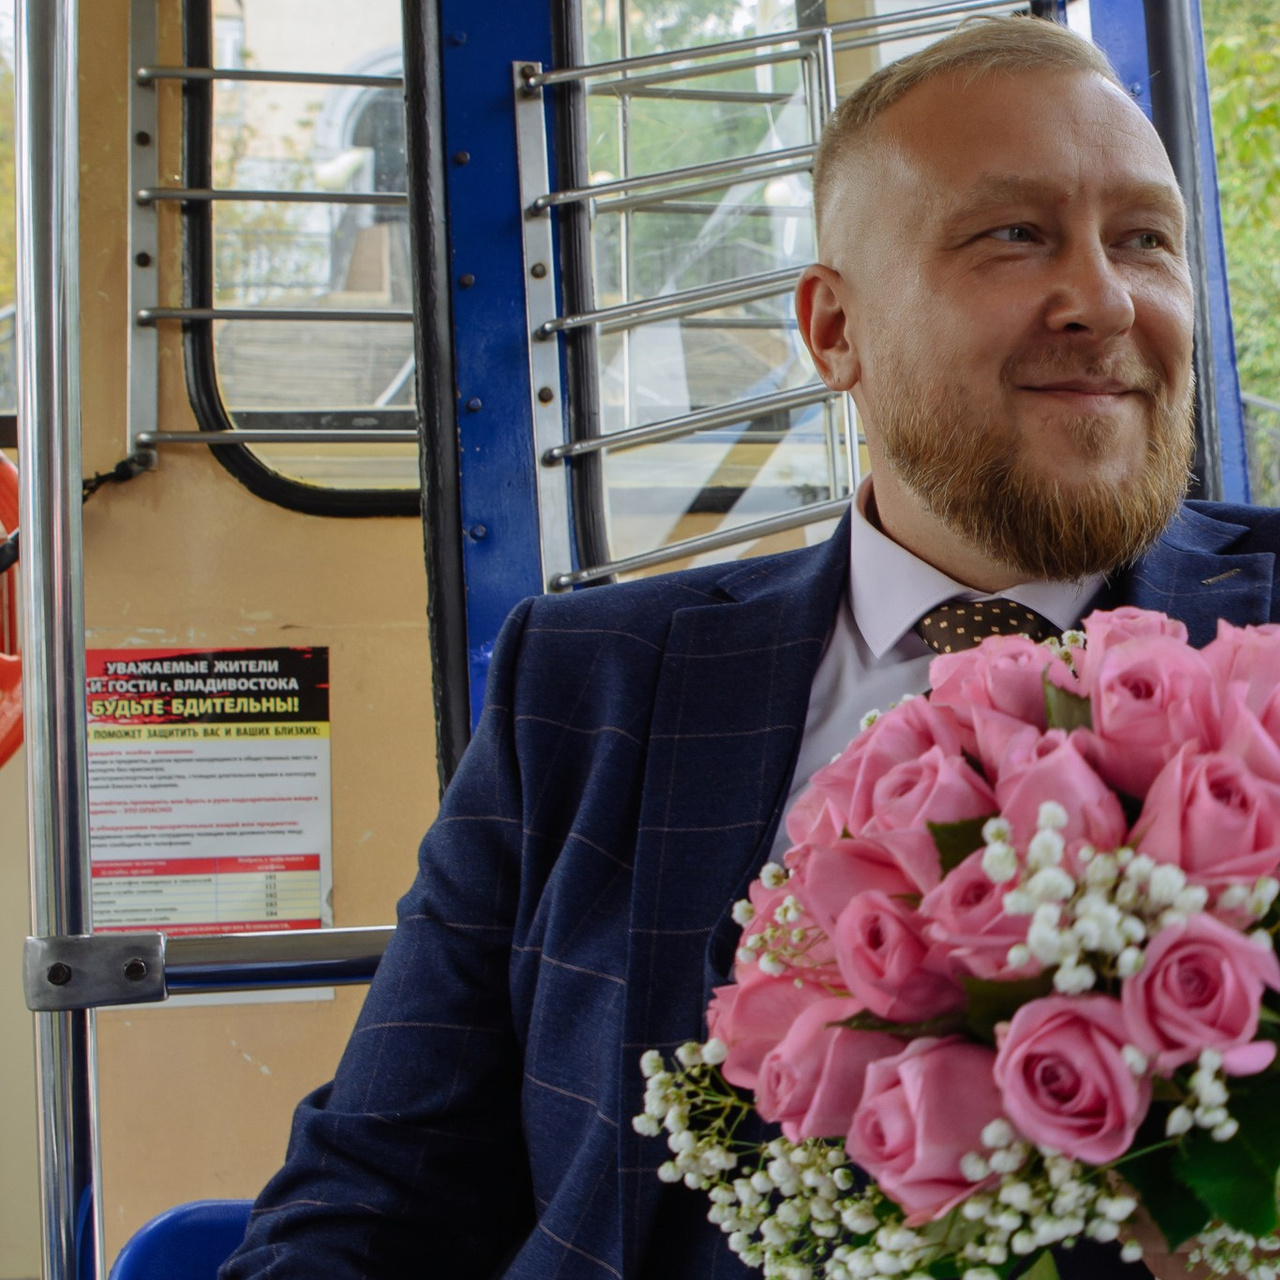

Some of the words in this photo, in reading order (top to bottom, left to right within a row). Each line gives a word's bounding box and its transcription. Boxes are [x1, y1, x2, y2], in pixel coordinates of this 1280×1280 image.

[107, 660, 208, 675] УВАЖАЕМЫЕ
[214, 660, 279, 674] ЖИТЕЛИ
[90, 680, 102, 693] И
[108, 679, 157, 693] ГОСТИ
[160, 682, 171, 692] г.
[174, 677, 299, 694] ВЛАДИВОСТОКА
[91, 698, 164, 718] БУДЬТЕ
[171, 696, 300, 716] БДИТЕЛЬНЫ!
[93, 729, 142, 740] ПОМОЖЕТ
[147, 728, 199, 739] ЗАЩИТИТЬ
[203, 727, 221, 738] ВАС
[225, 727, 232, 737] И
[236, 726, 271, 738] ВАШИХ
[274, 725, 321, 736] БЛИЗКИХ:
